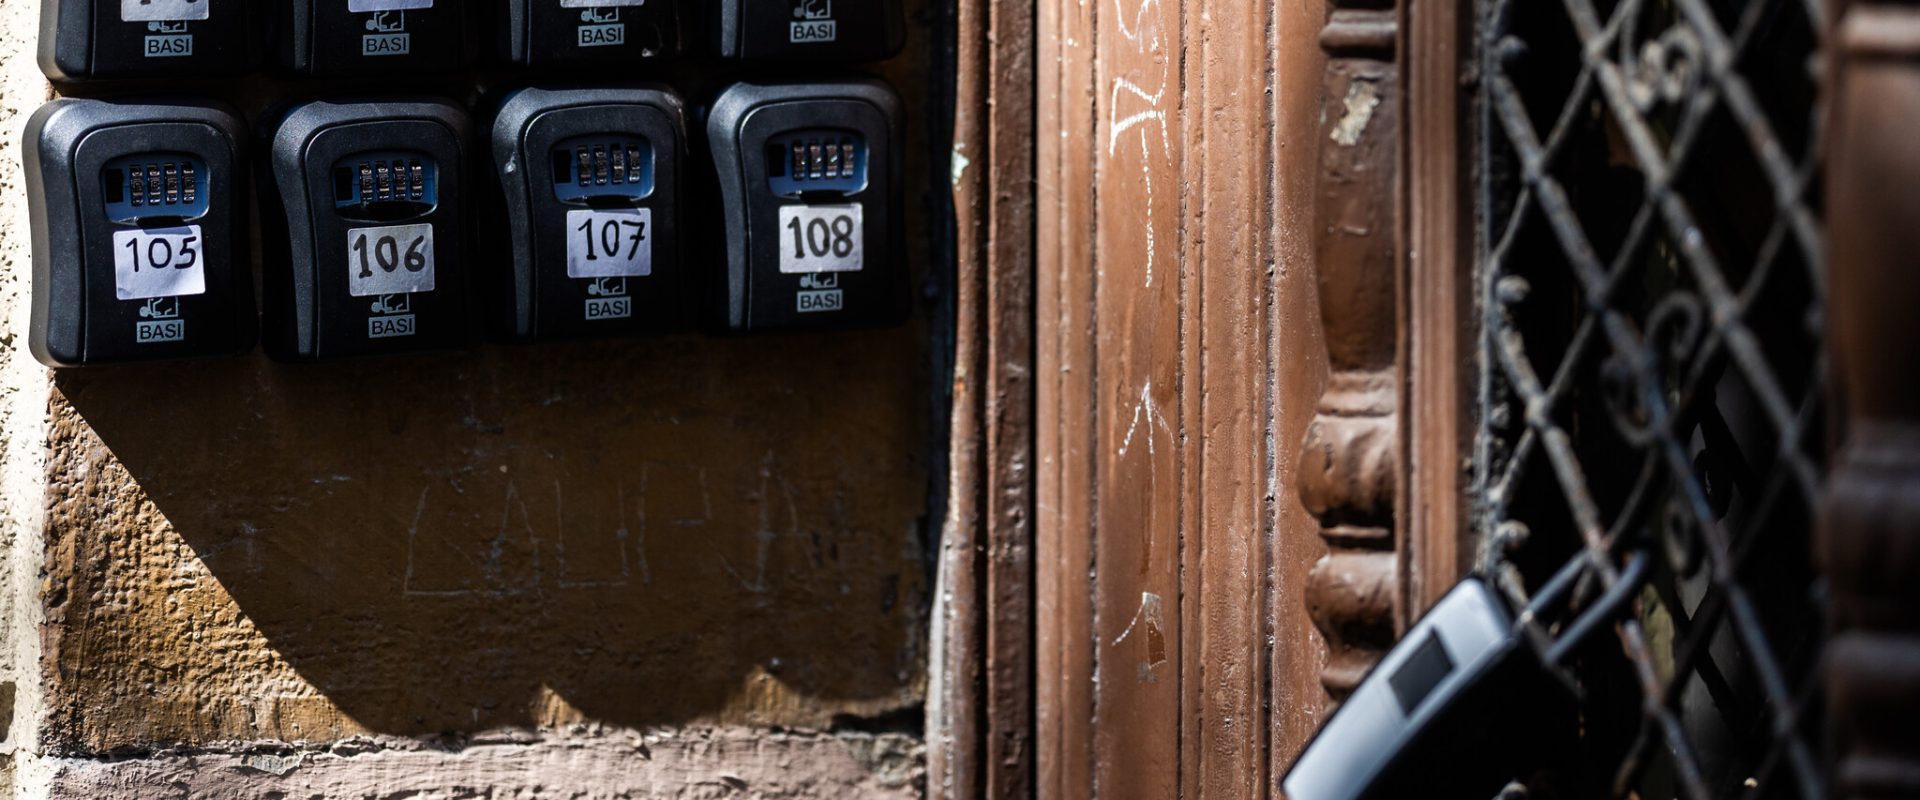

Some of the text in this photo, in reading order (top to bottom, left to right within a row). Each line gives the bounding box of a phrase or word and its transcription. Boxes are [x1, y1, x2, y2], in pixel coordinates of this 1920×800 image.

[581, 26, 622, 43] BASI
[793, 23, 833, 40] BASI
[148, 38, 190, 54] BASI
[366, 37, 408, 53] BASI
[578, 218, 646, 260] 107
[787, 215, 854, 259] 108
[125, 235, 198, 273] 105
[353, 234, 426, 279] 106
[588, 299, 629, 317] BASI
[800, 292, 841, 310] BASI
[139, 322, 182, 340] BASI
[371, 318, 414, 335] BASI
